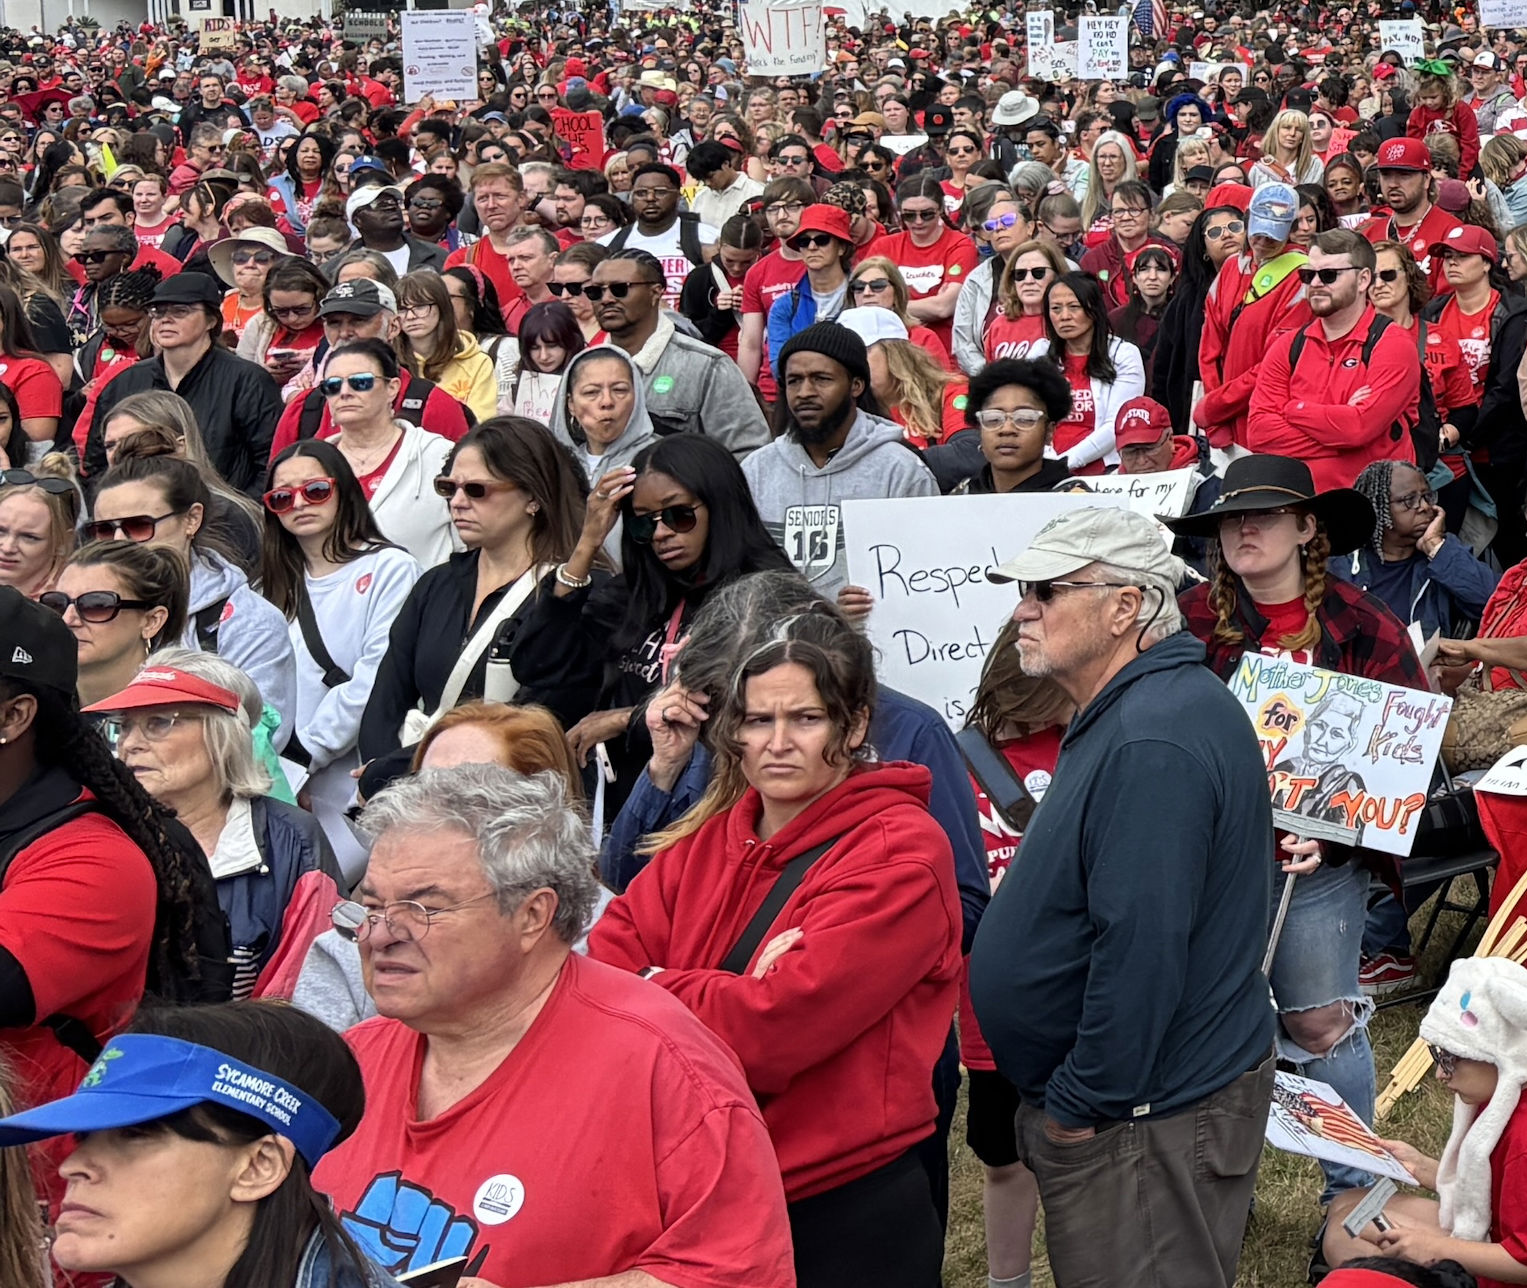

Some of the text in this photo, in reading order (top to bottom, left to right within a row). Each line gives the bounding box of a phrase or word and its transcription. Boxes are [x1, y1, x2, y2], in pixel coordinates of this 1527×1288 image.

[1128, 479, 1176, 506] for my
[788, 510, 836, 527] SENIORS
[792, 530, 829, 561] 16
[1234, 656, 1381, 706] Mother Jones
[1263, 702, 1298, 733] for
[1383, 691, 1449, 738] Fought
[1369, 724, 1426, 766] Kids
[1331, 789, 1429, 837] YOU?
[211, 1079, 294, 1127] ELEMENTARY SCHOOL
[215, 1064, 303, 1114] SYCAMORE CREEK
[486, 1181, 516, 1205] KIDS
